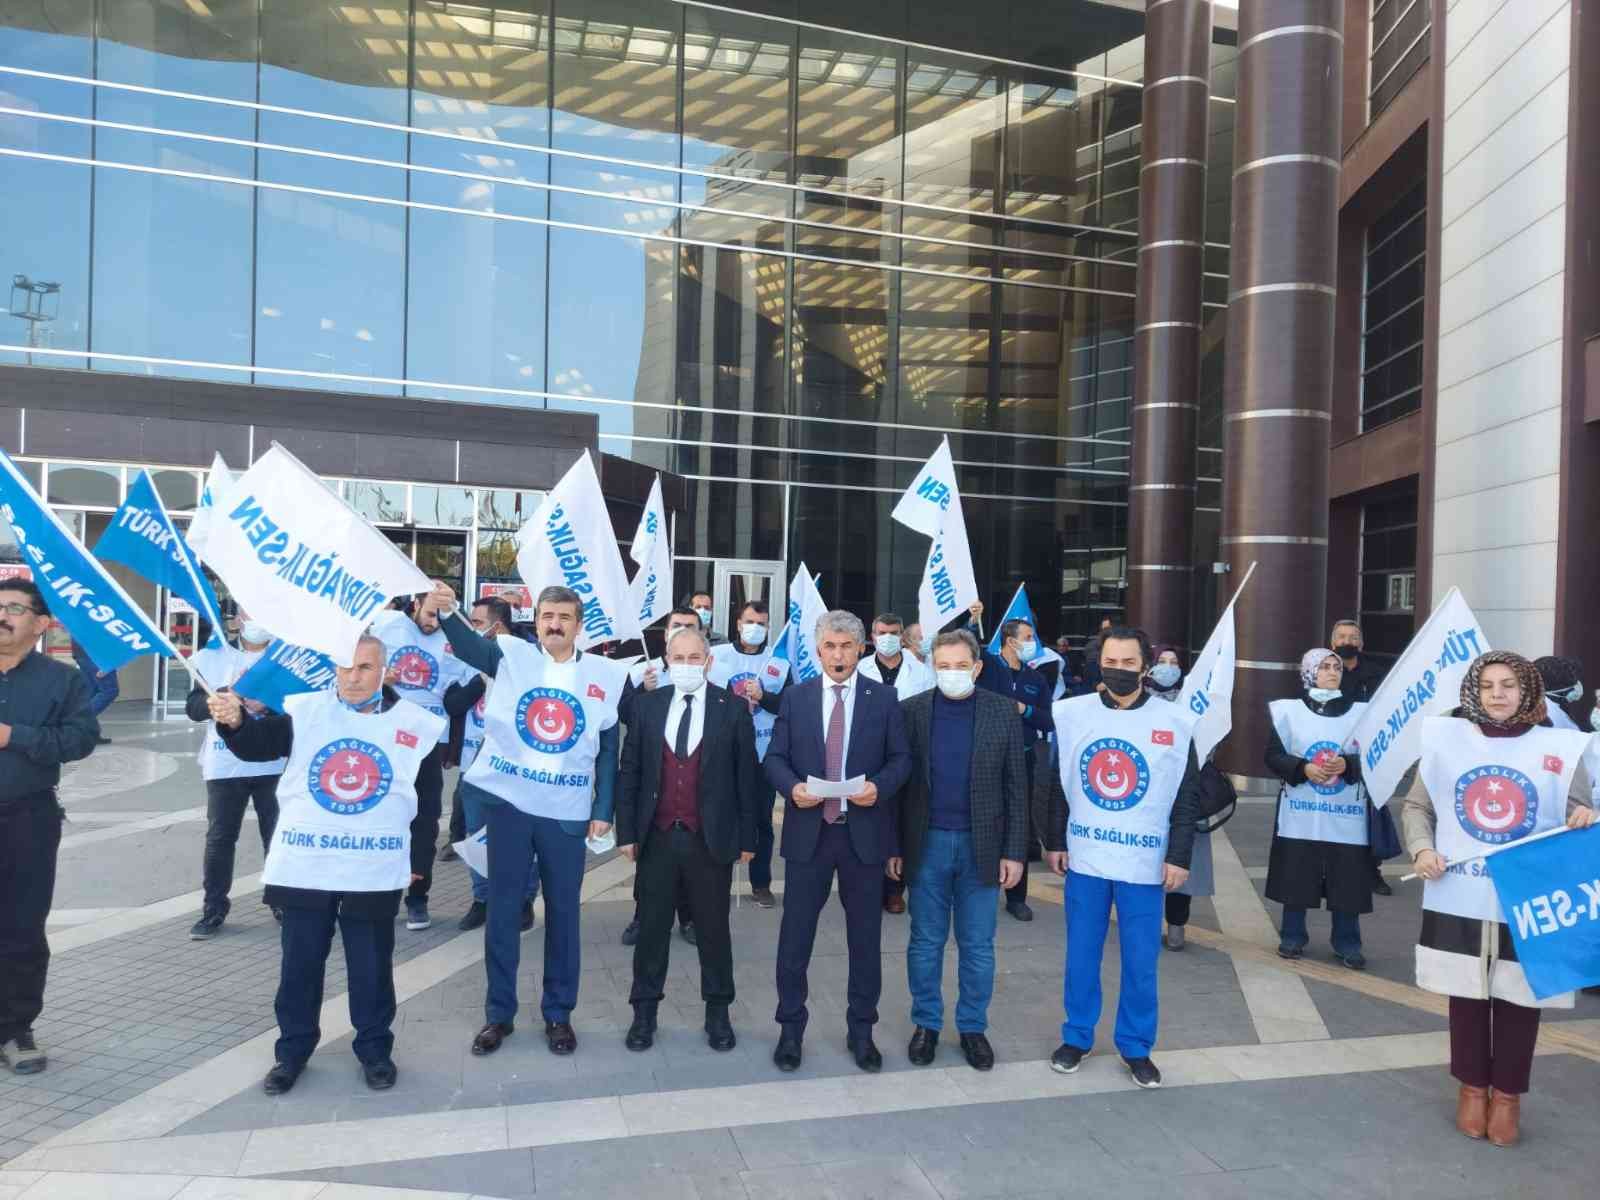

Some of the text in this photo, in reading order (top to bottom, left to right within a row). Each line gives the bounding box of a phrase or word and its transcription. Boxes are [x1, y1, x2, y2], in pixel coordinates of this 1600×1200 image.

[118, 505, 175, 551] TÜRK
[488, 754, 590, 788] TÜRK SAĞLIK-SEN
[281, 828, 404, 851] TÜRK SAĞLIK-SEN
[1093, 827, 1162, 849] SAĞLIK-SEN
